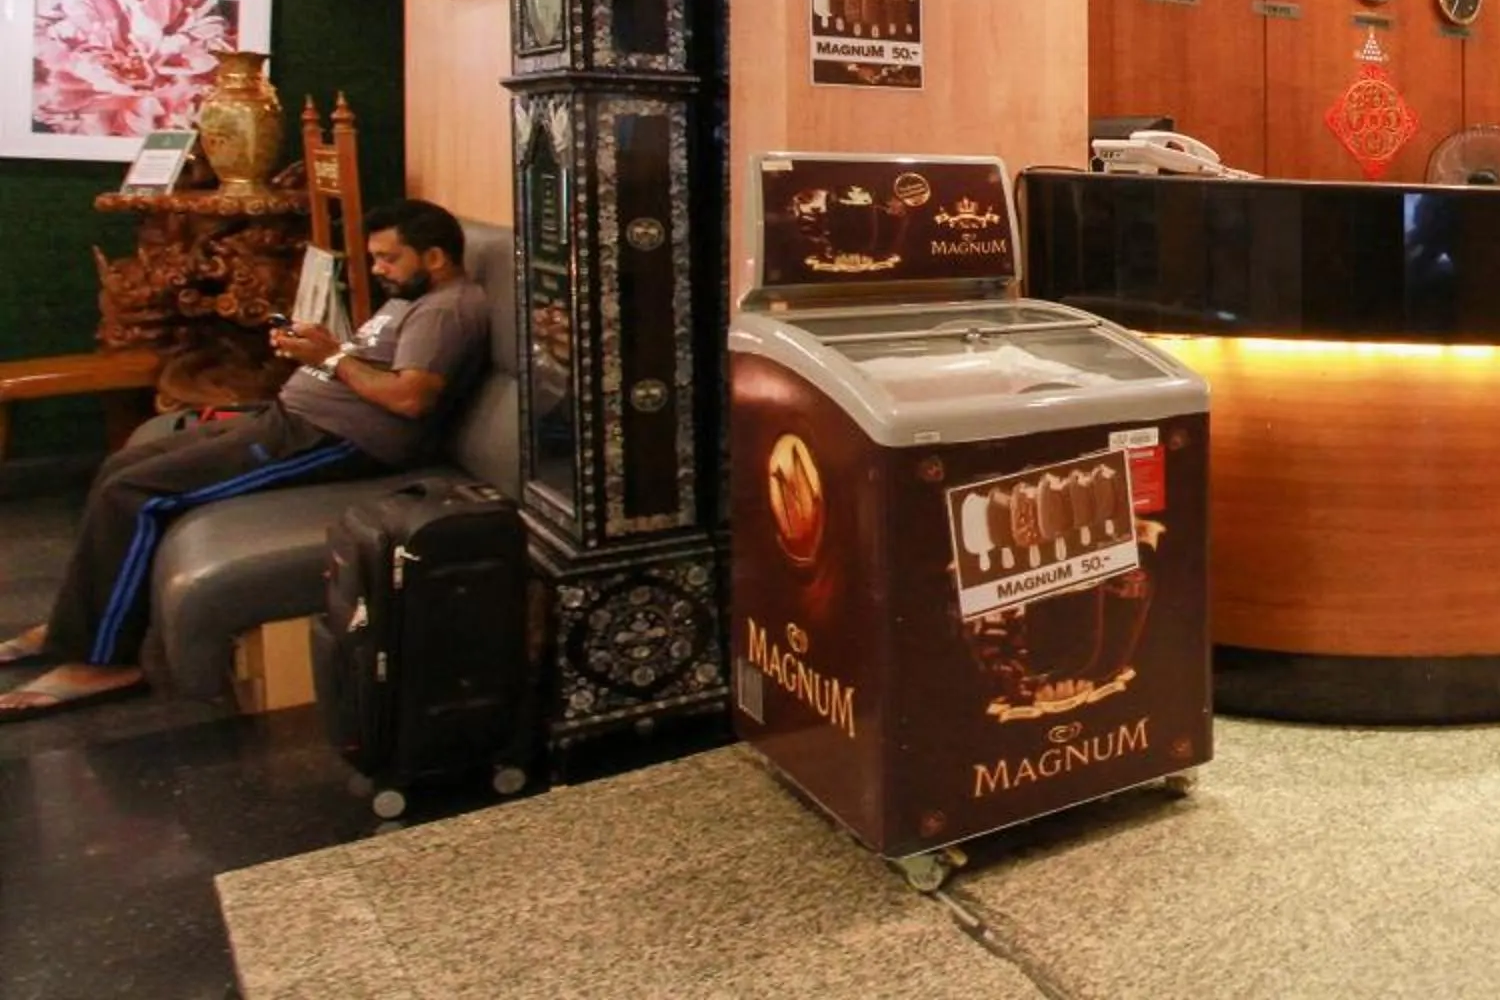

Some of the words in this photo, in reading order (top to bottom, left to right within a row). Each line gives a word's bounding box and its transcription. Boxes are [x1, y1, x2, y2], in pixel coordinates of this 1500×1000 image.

[816, 41, 885, 58] MAGNUM
[931, 239, 1007, 255] MAGNUM
[996, 564, 1073, 599] MAGNUM
[1081, 555, 1112, 573] 50.-
[748, 617, 856, 738] MAGNUM
[973, 717, 1149, 798] MAGNUM
